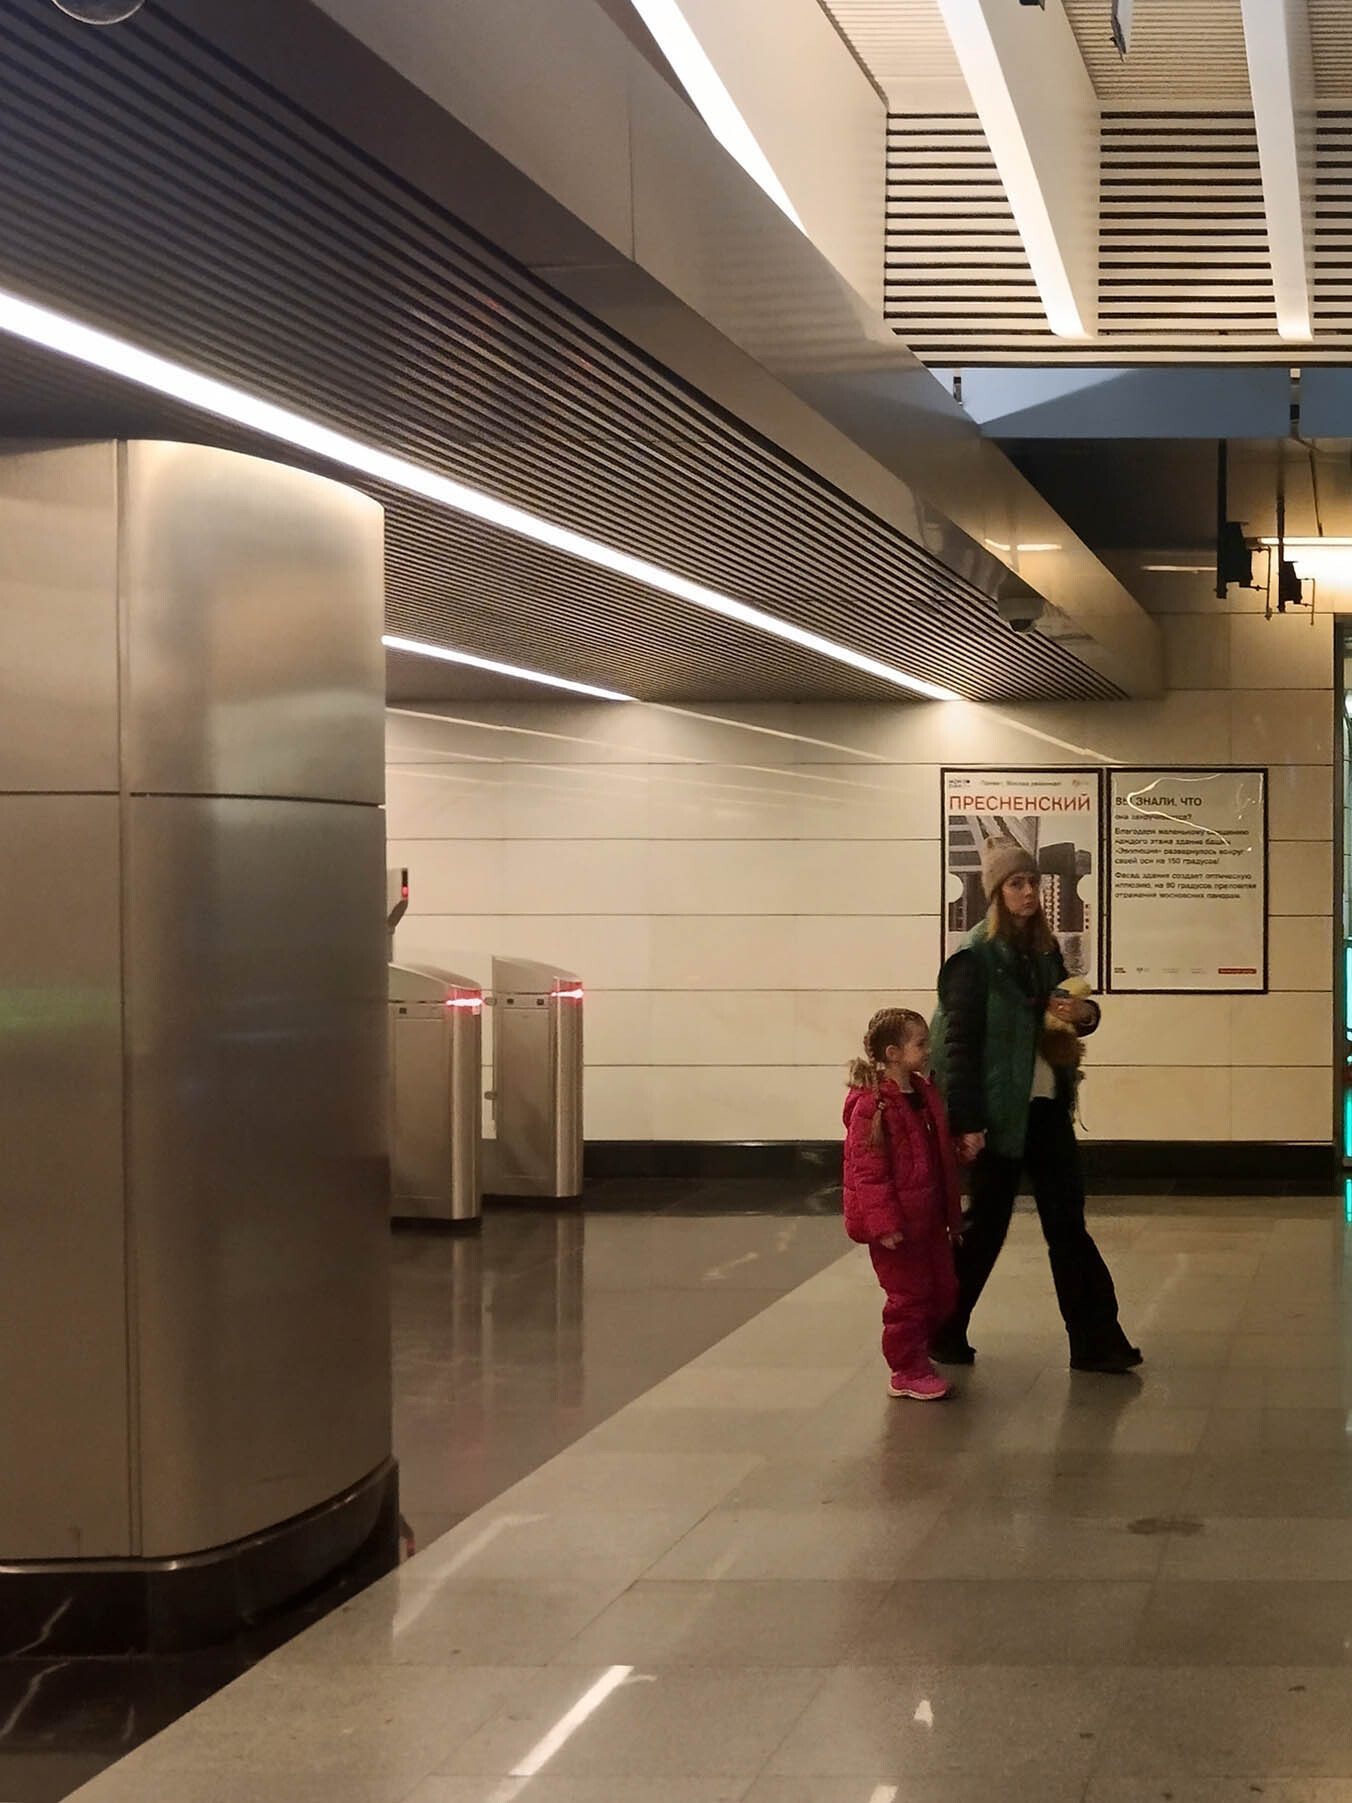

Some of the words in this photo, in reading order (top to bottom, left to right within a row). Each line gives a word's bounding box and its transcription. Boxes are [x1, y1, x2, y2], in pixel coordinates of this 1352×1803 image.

[949, 793, 1091, 811] ПРЕСНЕНСКИЙ
[1136, 797, 1178, 807] ЗНАЛИ,
[1180, 797, 1203, 806] ЧТО
